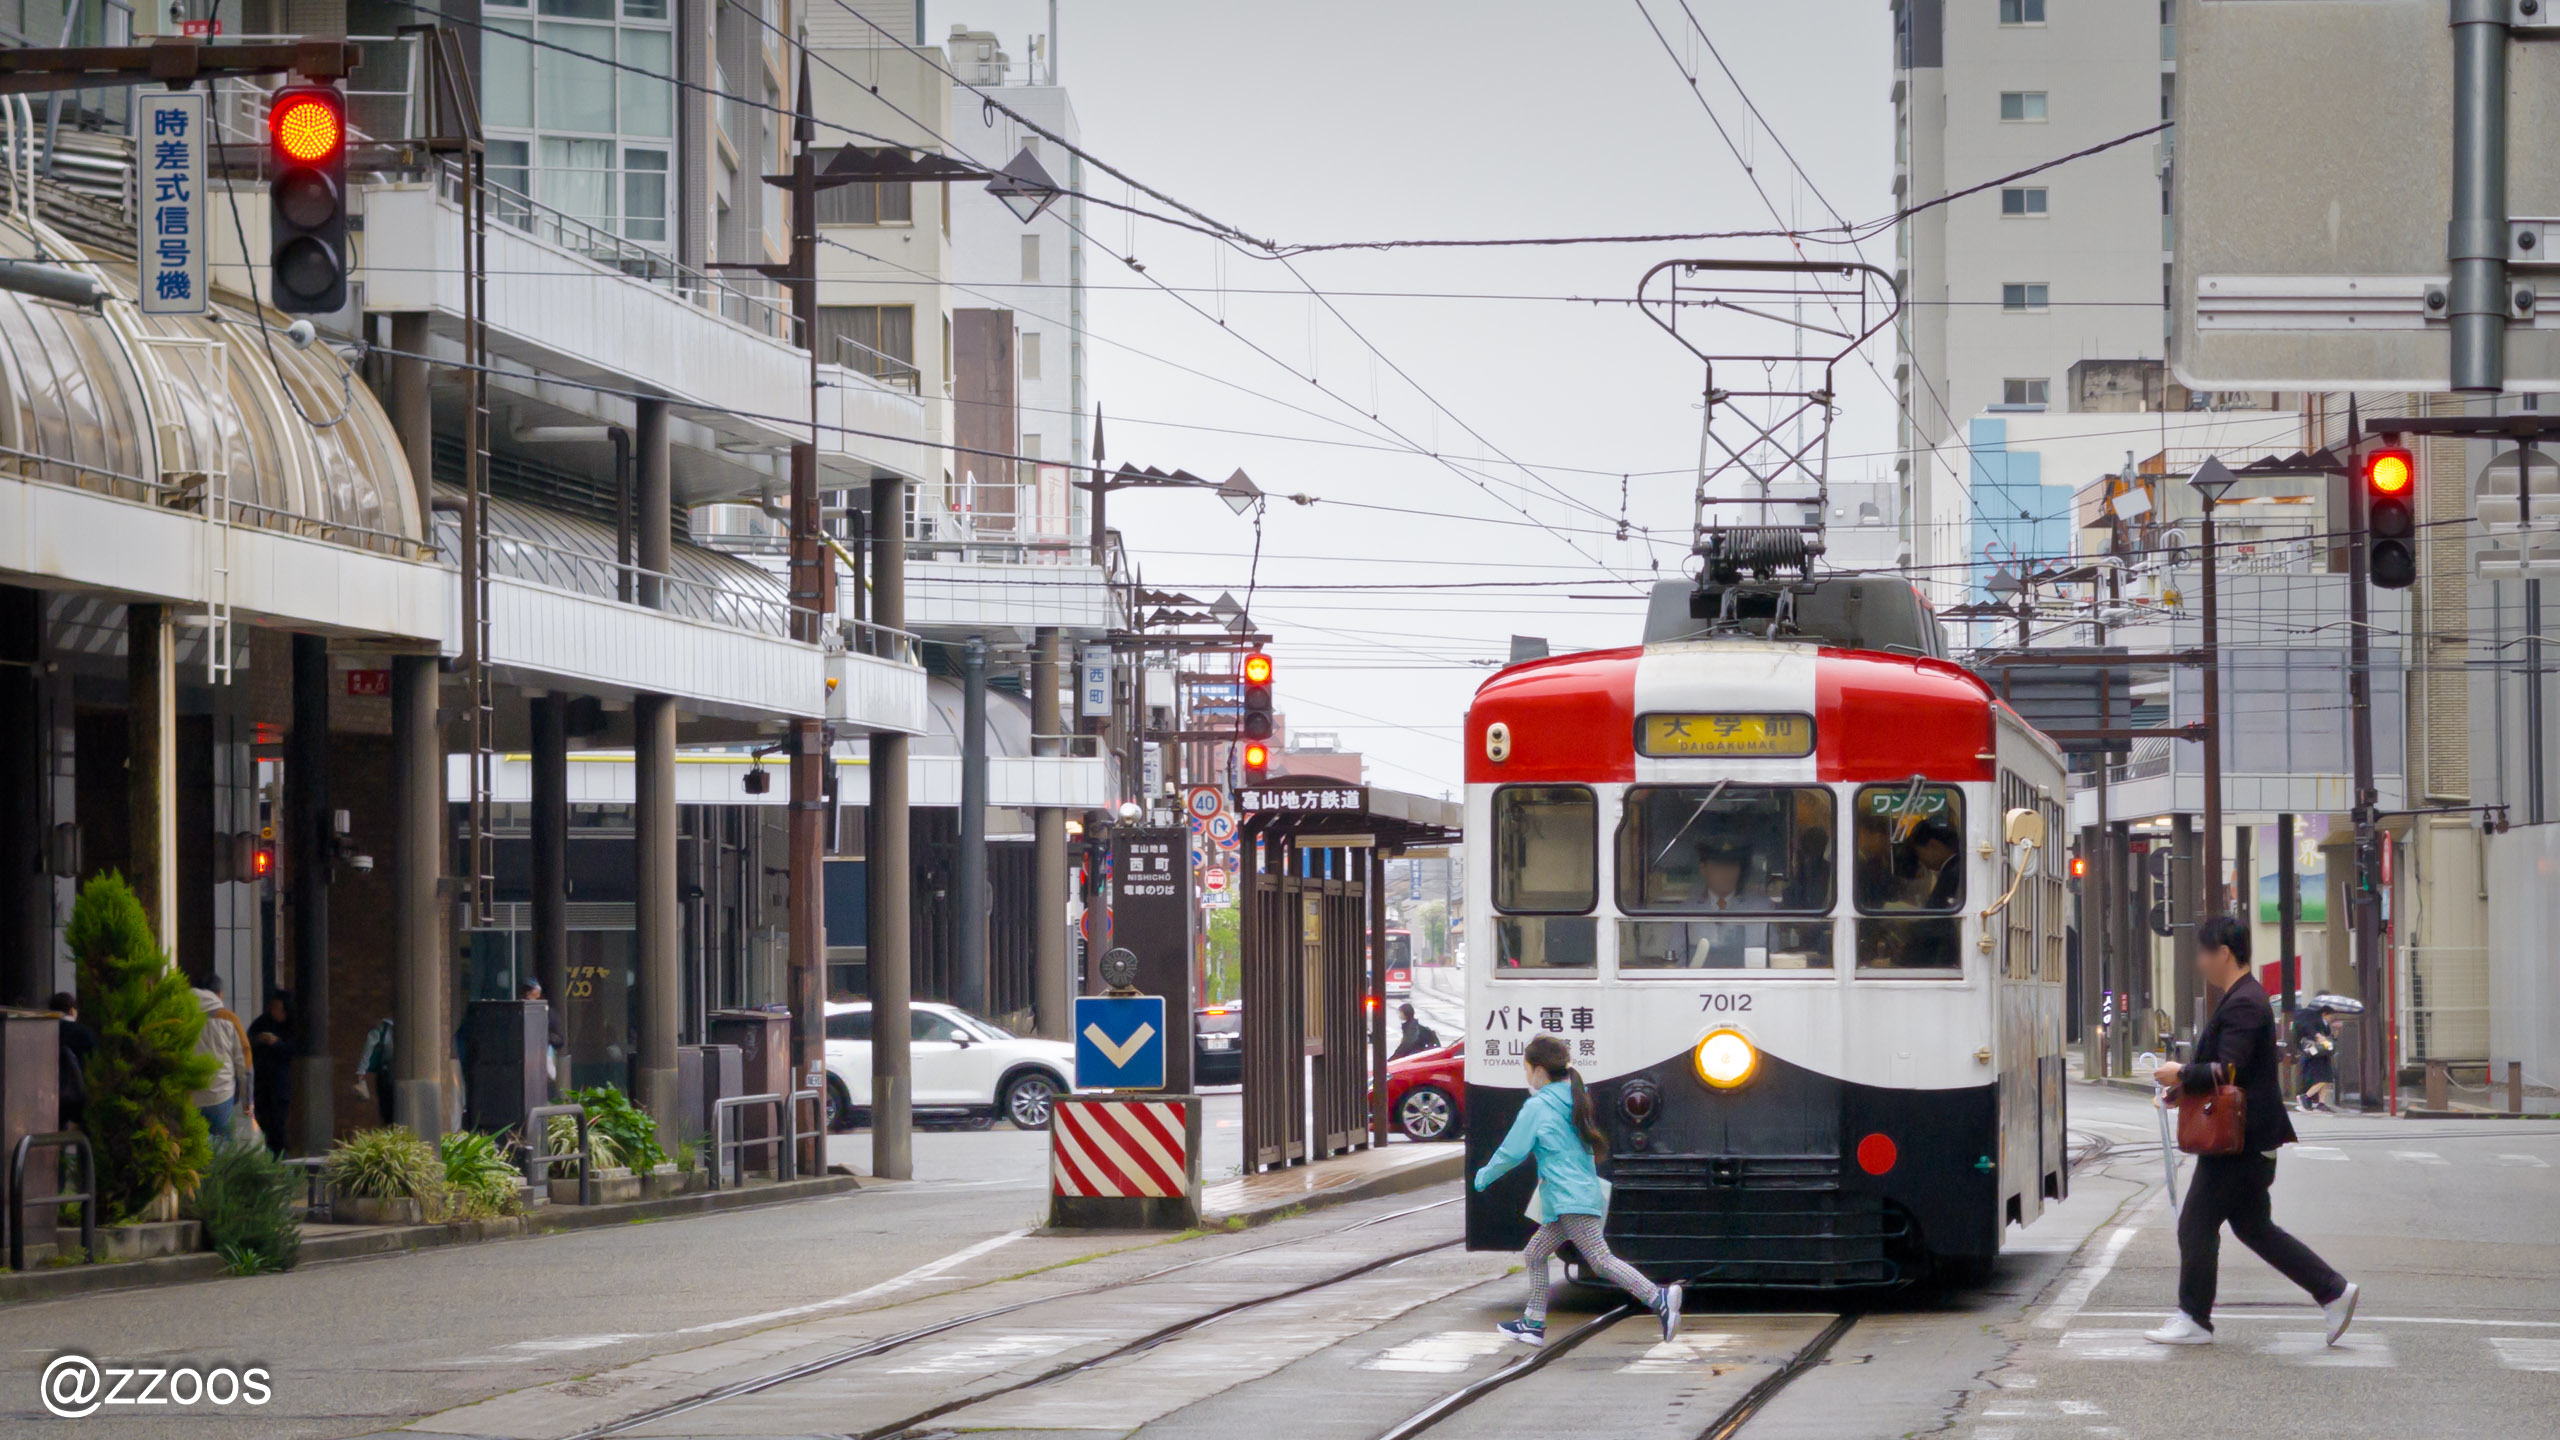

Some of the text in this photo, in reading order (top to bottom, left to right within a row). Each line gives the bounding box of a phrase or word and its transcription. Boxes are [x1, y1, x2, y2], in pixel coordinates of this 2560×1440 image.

[154, 107, 192, 300] 時差式信号機
[1089, 667, 1105, 704] 西町
[1663, 716, 1793, 738] 大学前
[1679, 740, 1777, 751] DAIGAKUMAE
[1195, 794, 1216, 812] 40
[1241, 790, 1360, 810] 富山地方鉄道
[1873, 794, 1946, 814] ワンマン
[1129, 857, 1170, 872] 西町
[1123, 884, 1176, 896] 電車のりば
[1698, 993, 1753, 1012] 7012
[1485, 1005, 1595, 1033] パト電車
[1483, 1058, 1598, 1067] TOYAMA Police
